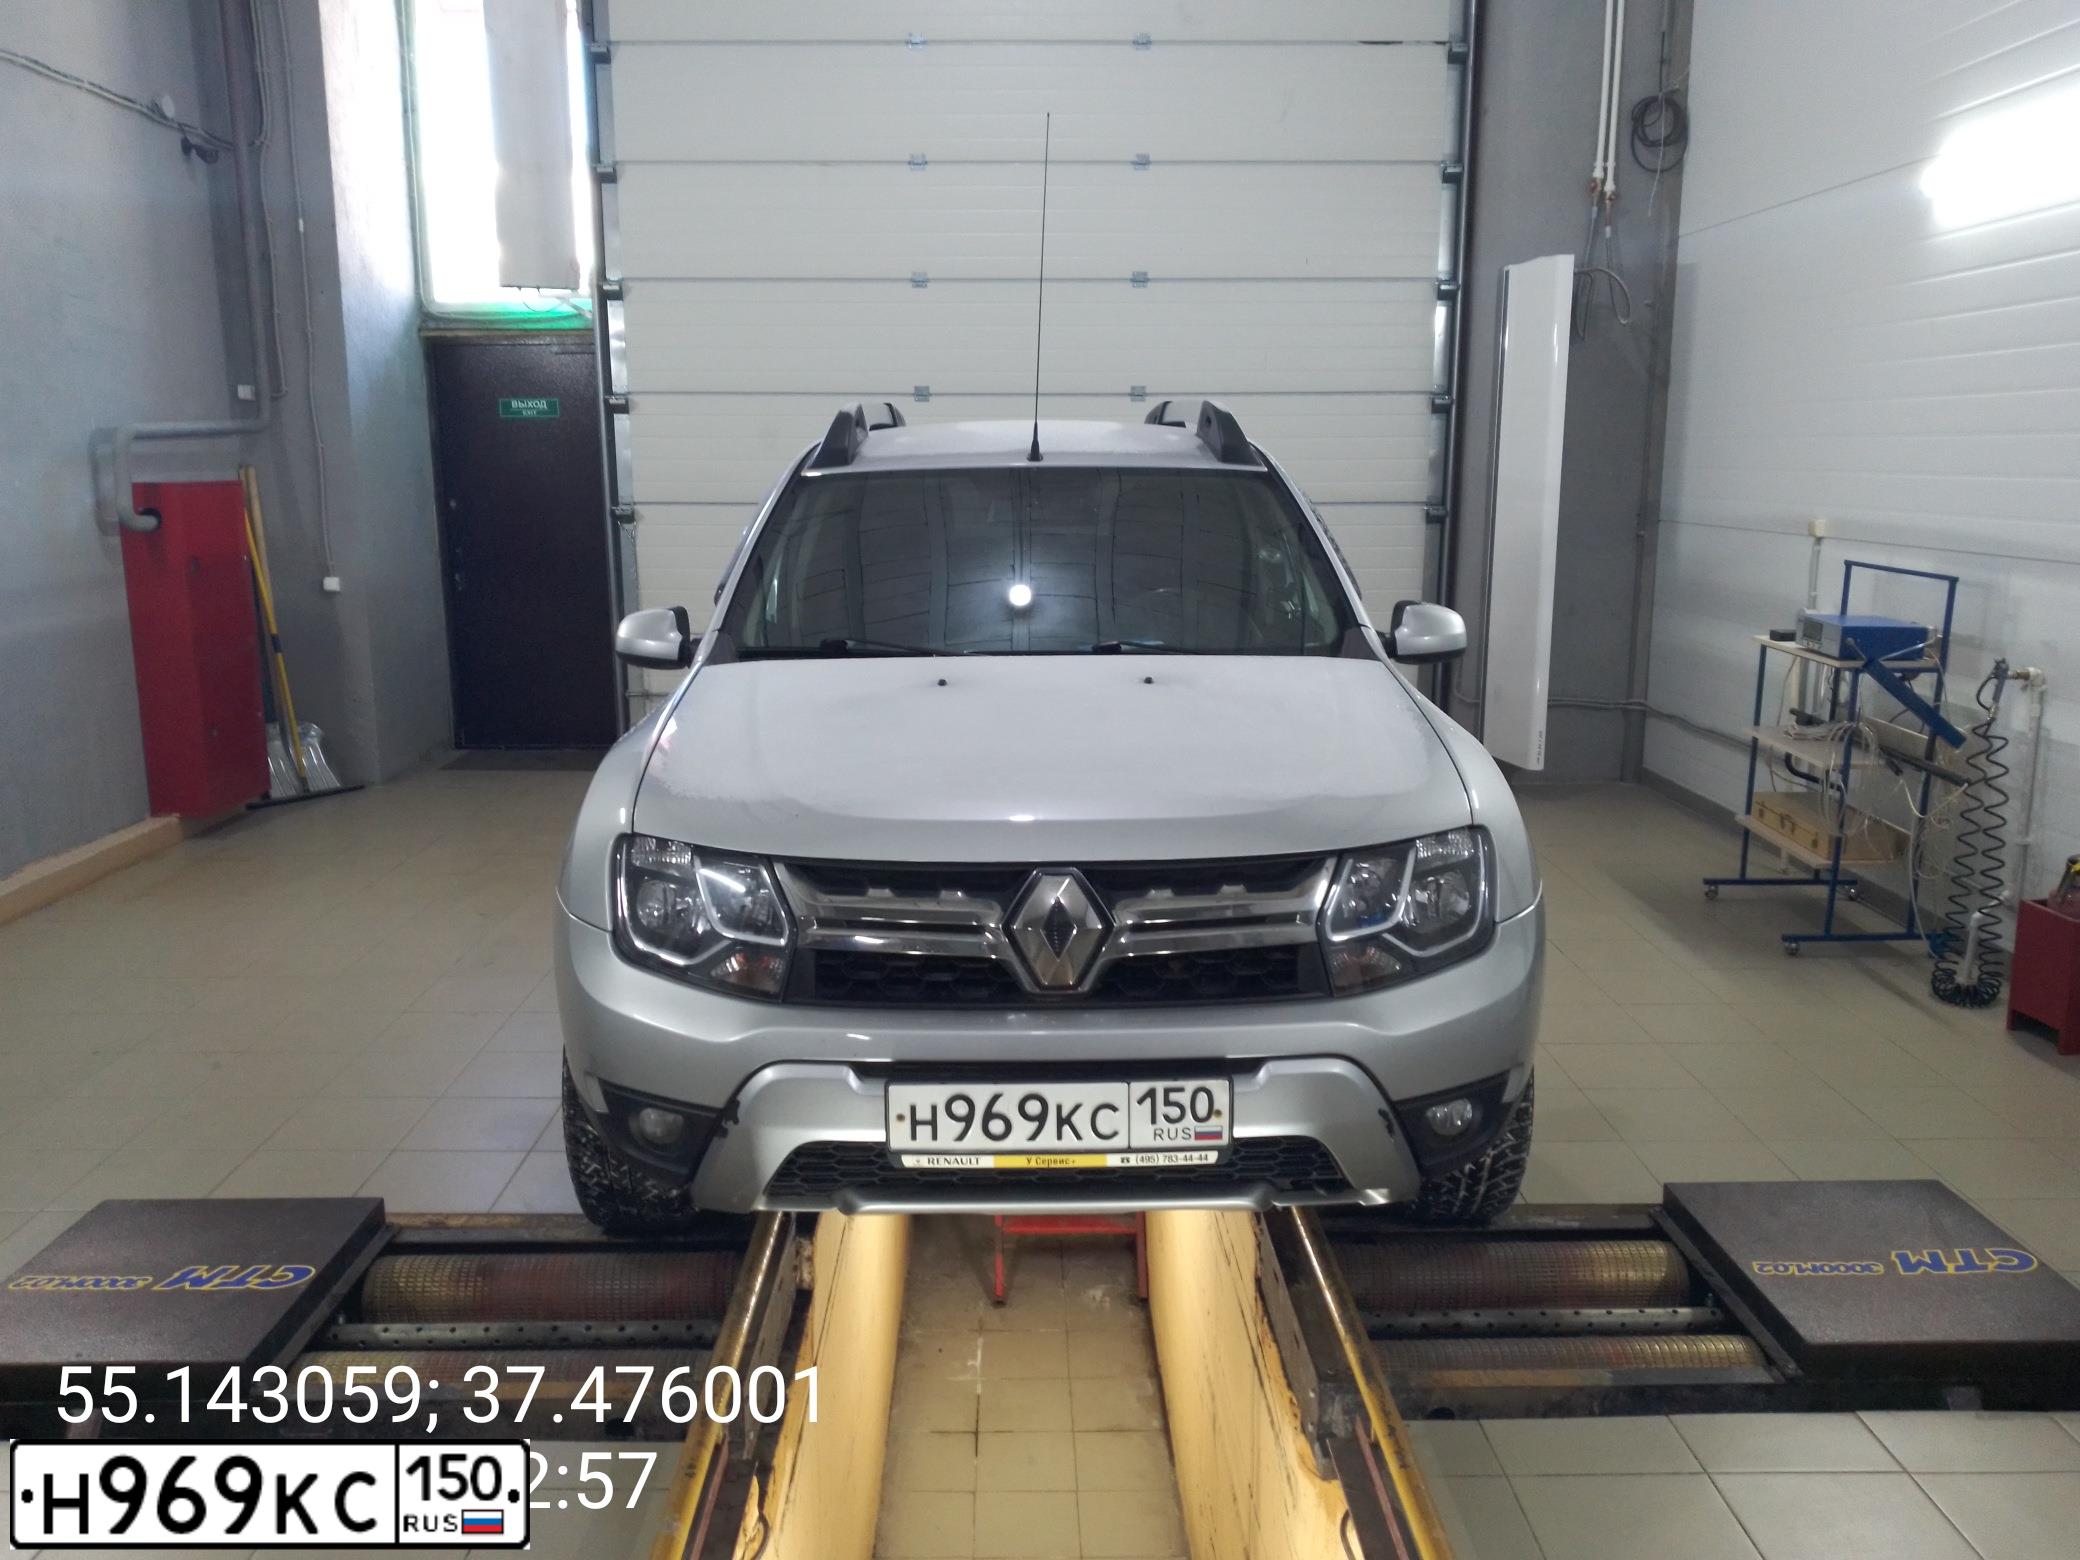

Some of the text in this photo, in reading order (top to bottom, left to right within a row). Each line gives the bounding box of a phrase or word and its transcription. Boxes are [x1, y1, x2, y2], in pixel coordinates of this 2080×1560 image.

[511, 400, 547, 409] ВЫХОД
[1137, 1086, 1214, 1125] 150
[1153, 1128, 1191, 1141] RUS
[927, 1157, 980, 1166] RENAULT
[1135, 1153, 1209, 1165] (495) 783-44-44
